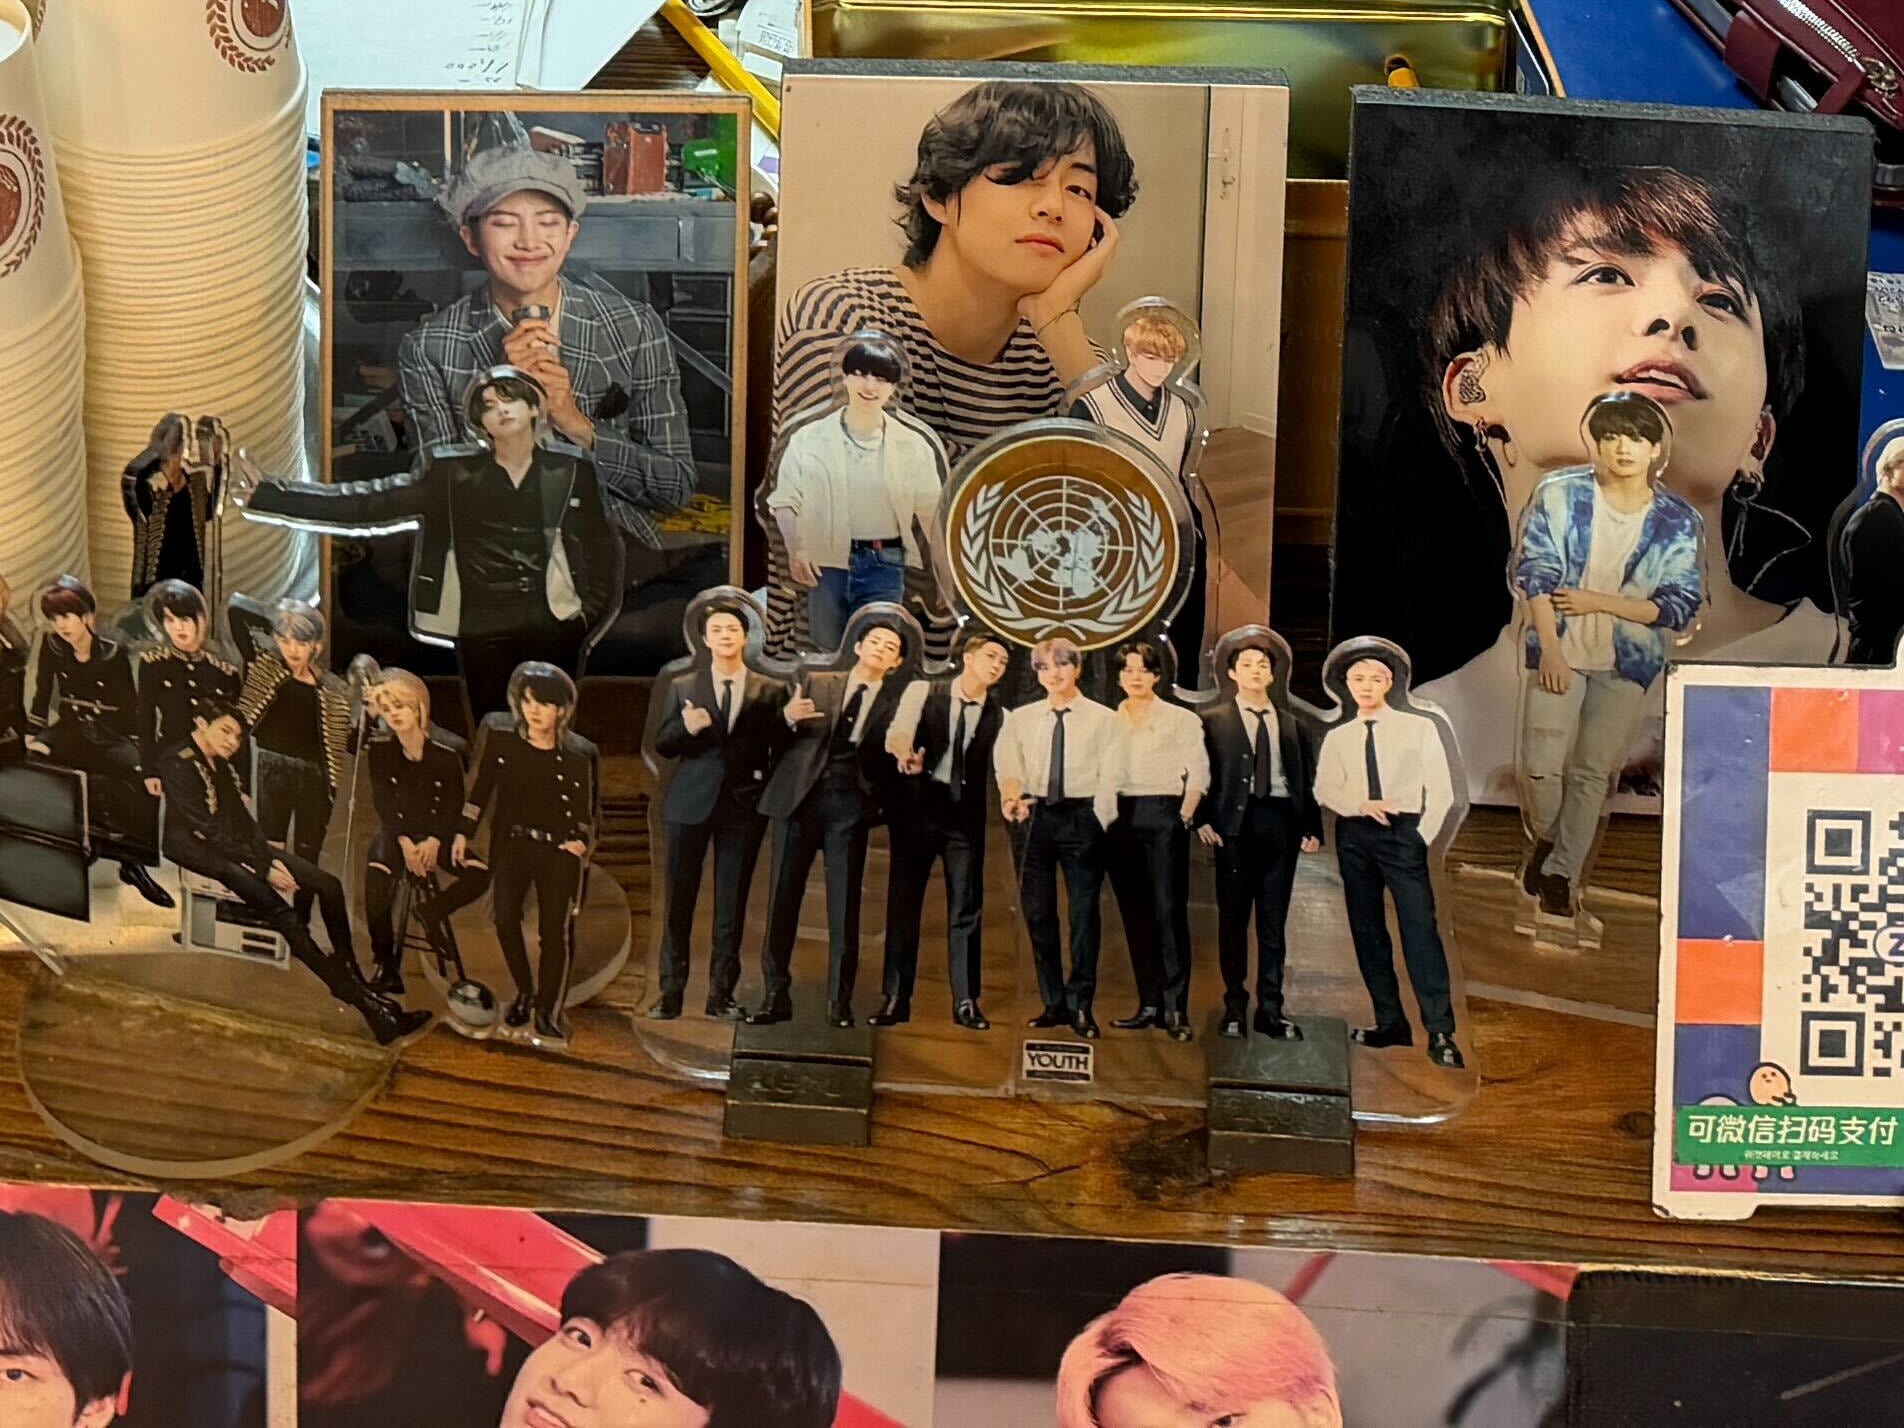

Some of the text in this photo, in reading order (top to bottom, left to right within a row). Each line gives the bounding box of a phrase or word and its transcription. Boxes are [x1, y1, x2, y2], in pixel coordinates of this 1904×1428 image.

[1026, 1052, 1090, 1071] YOUTH
[1687, 1113, 1898, 1145] 可微信扫码支付
